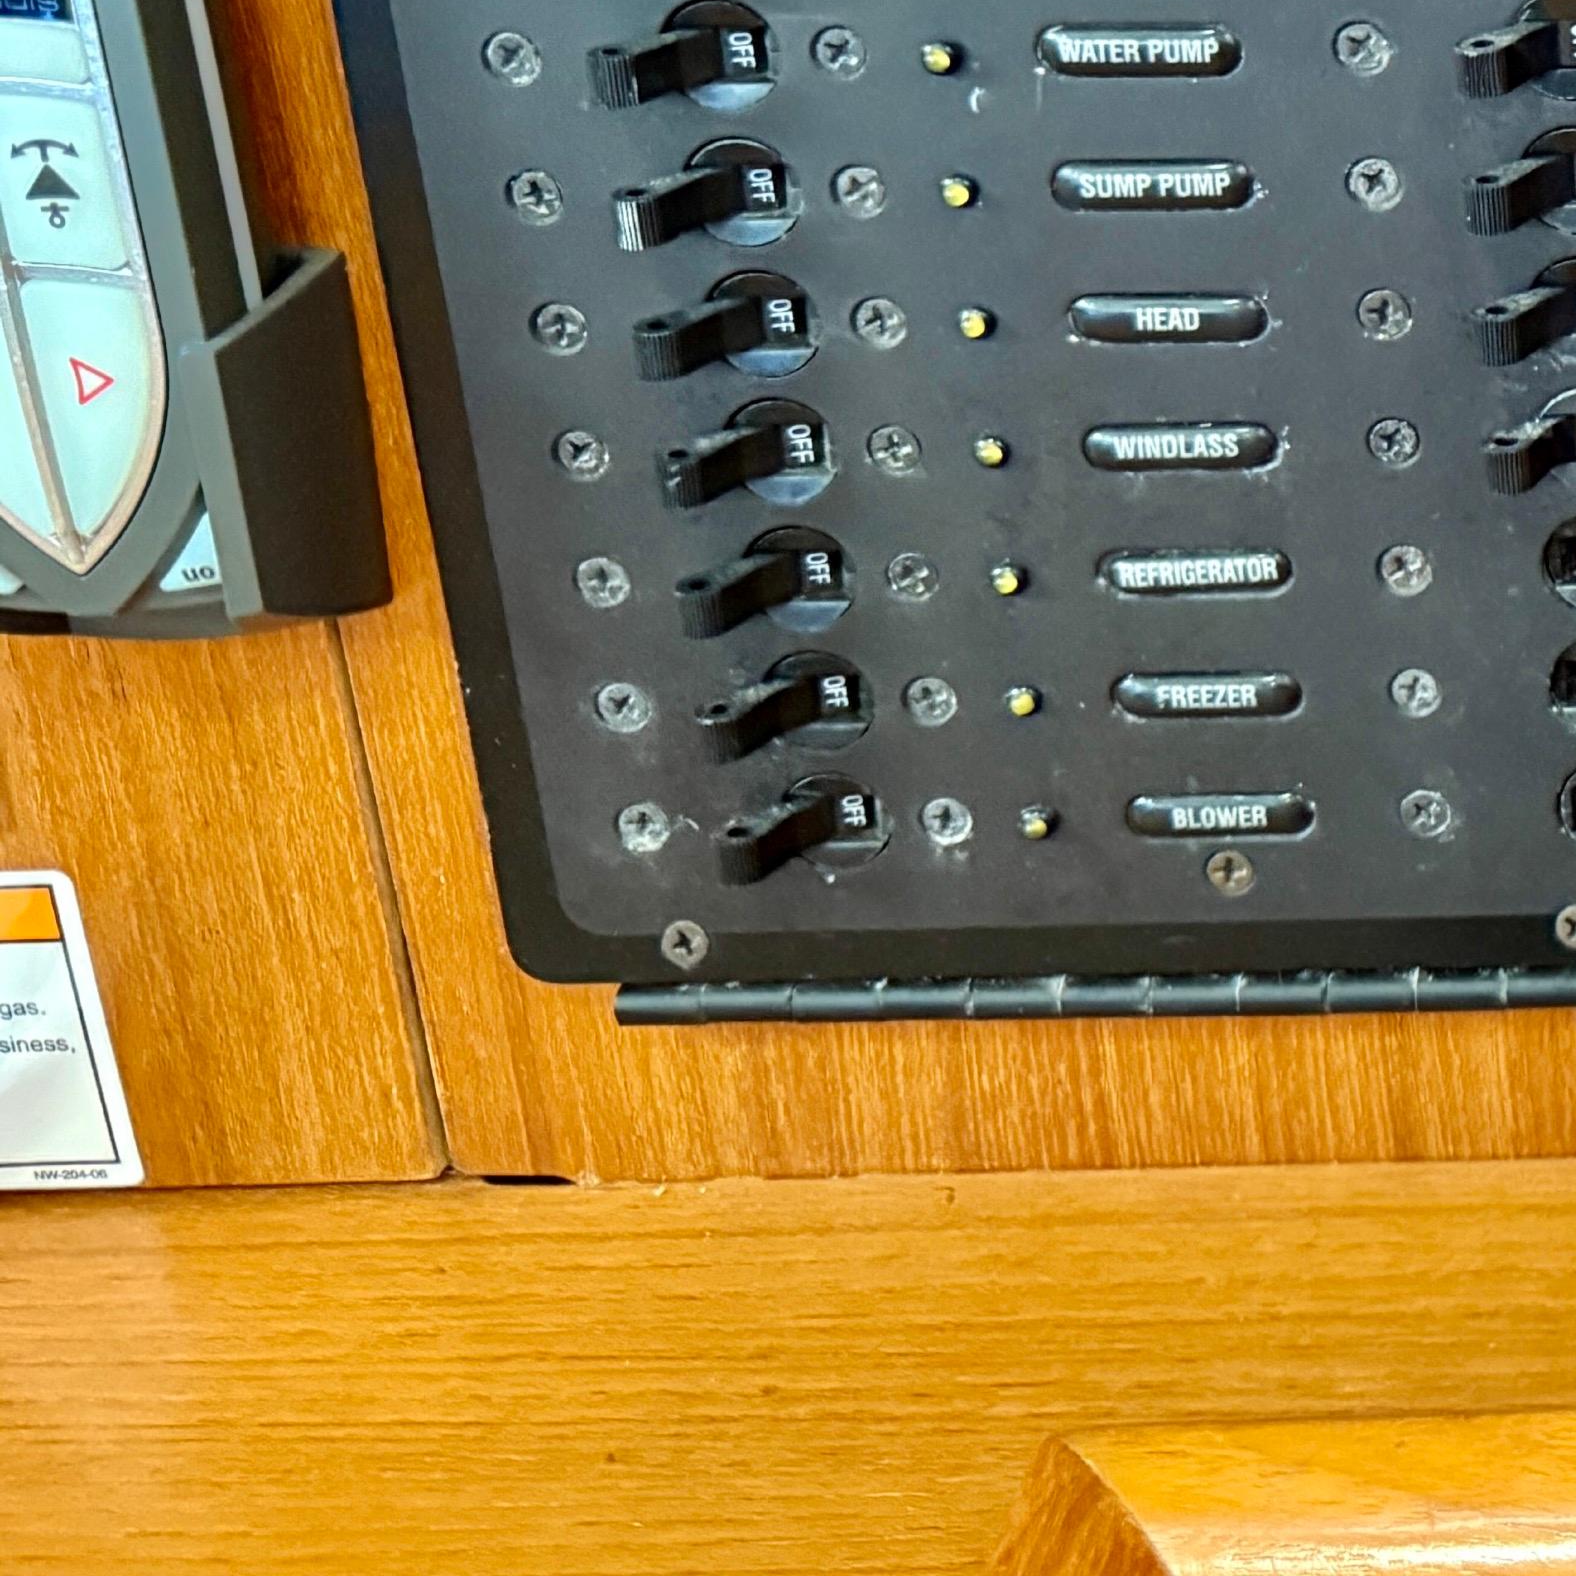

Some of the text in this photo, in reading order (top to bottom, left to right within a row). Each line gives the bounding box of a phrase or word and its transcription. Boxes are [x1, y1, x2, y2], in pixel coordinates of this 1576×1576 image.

[728, 31, 756, 69] OFF
[1060, 37, 1218, 64] WATER PUMP
[749, 169, 776, 205] OFF
[1080, 172, 1231, 198] SUMP PUMP
[768, 298, 796, 333] OFF
[1135, 306, 1200, 332] HEAD
[786, 424, 813, 464] OFF
[1114, 433, 1239, 459] WINDLASS
[805, 551, 831, 586] OFF
[1118, 556, 1279, 588] REFRIGERATOR
[822, 675, 850, 711] OFF
[1156, 682, 1257, 708] FREEZER
[840, 794, 867, 827] OFF
[1171, 804, 1268, 830] BLOWER
